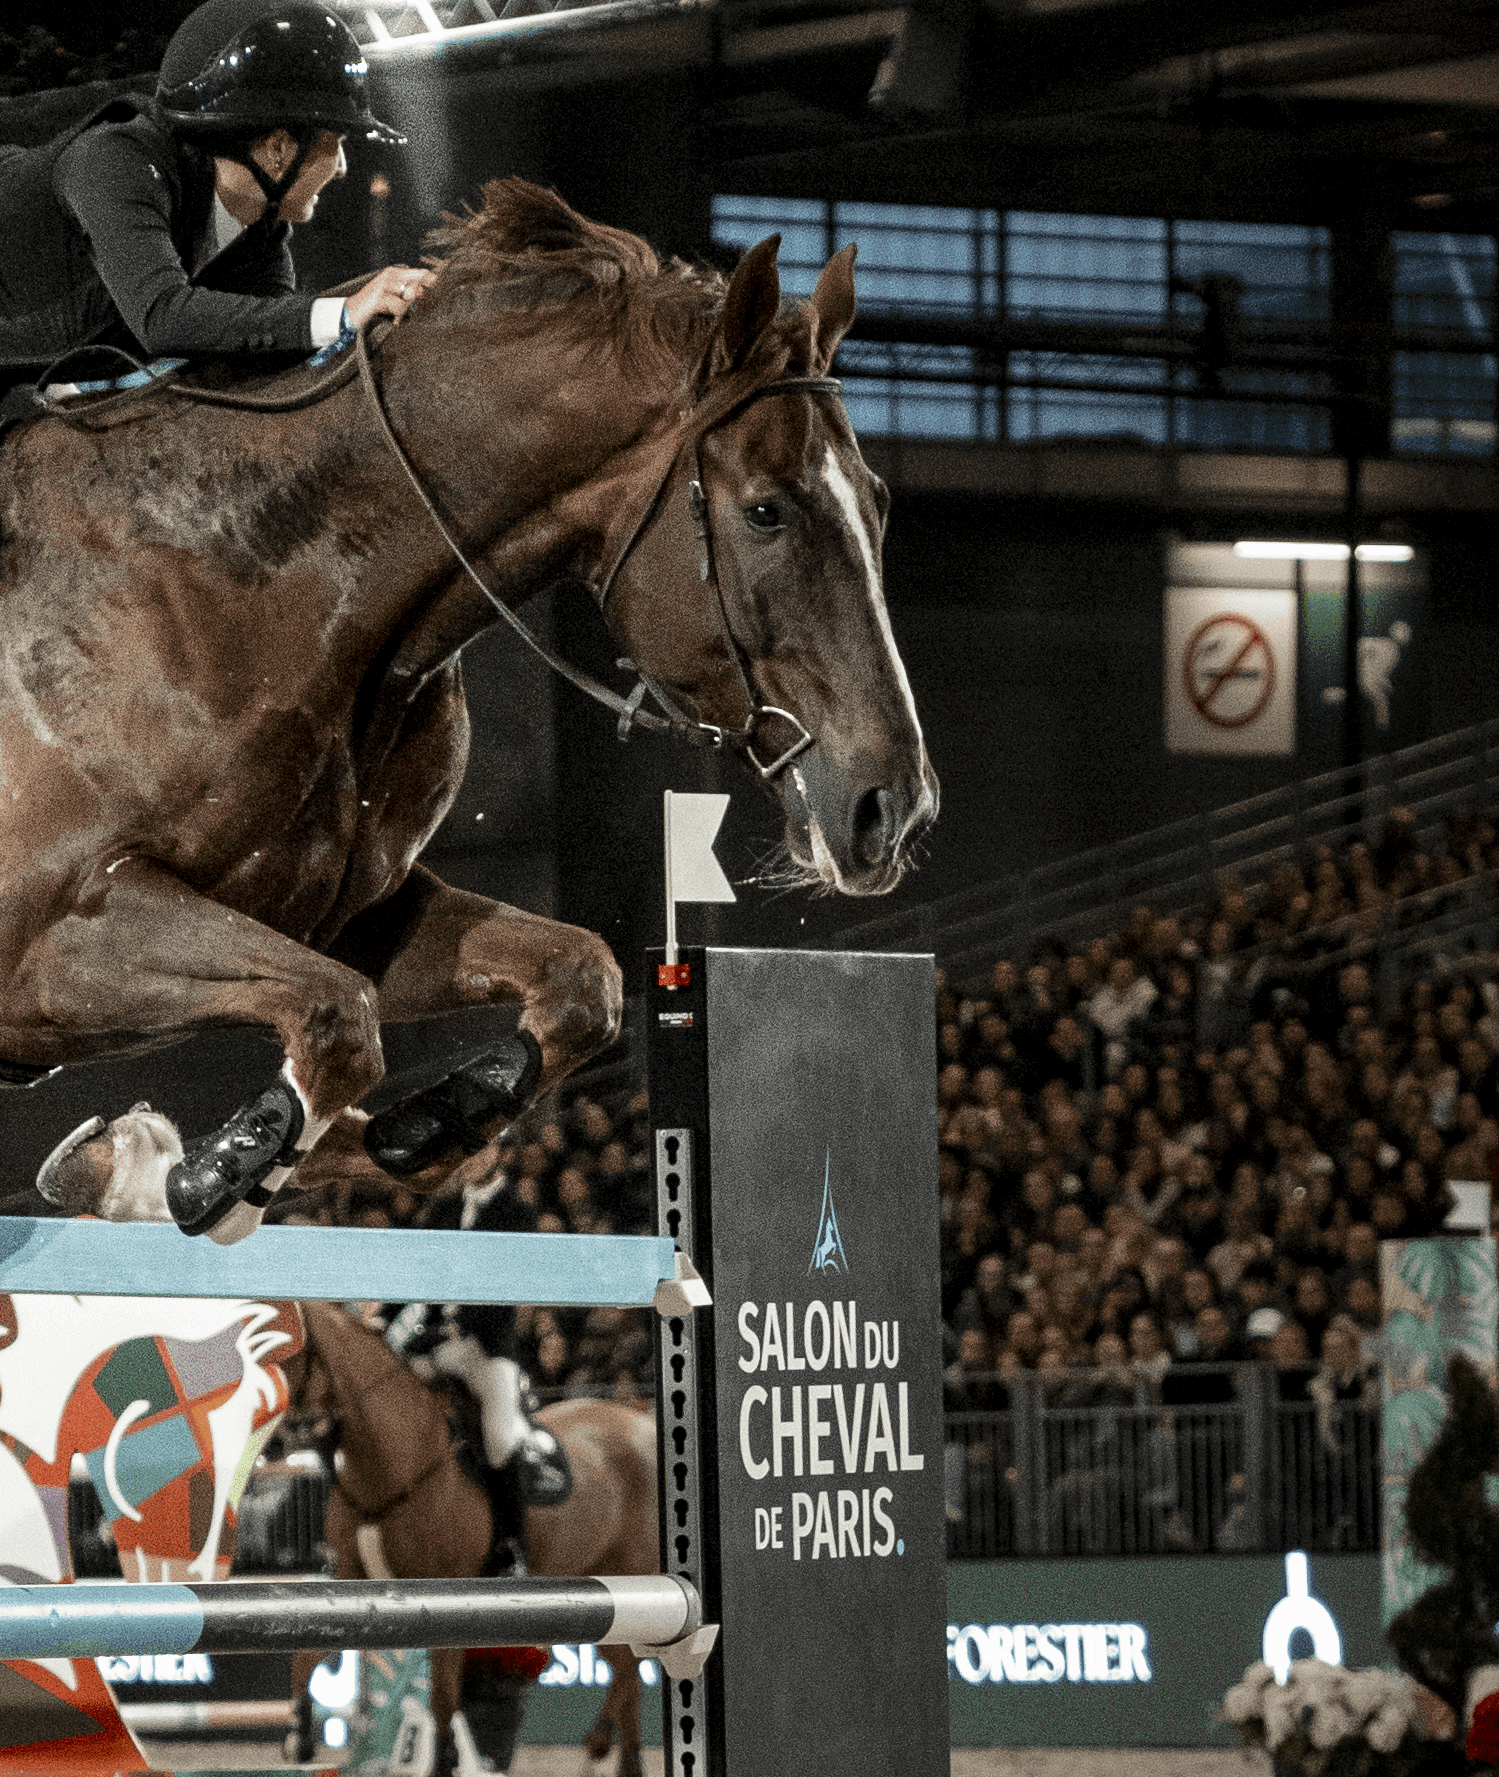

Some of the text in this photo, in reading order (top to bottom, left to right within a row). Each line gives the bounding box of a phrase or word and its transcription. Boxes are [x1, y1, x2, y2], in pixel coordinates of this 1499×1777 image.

[737, 1299, 900, 1373] SALON DU
[739, 1381, 924, 1480] CHEVAL
[754, 1506, 784, 1551] DE
